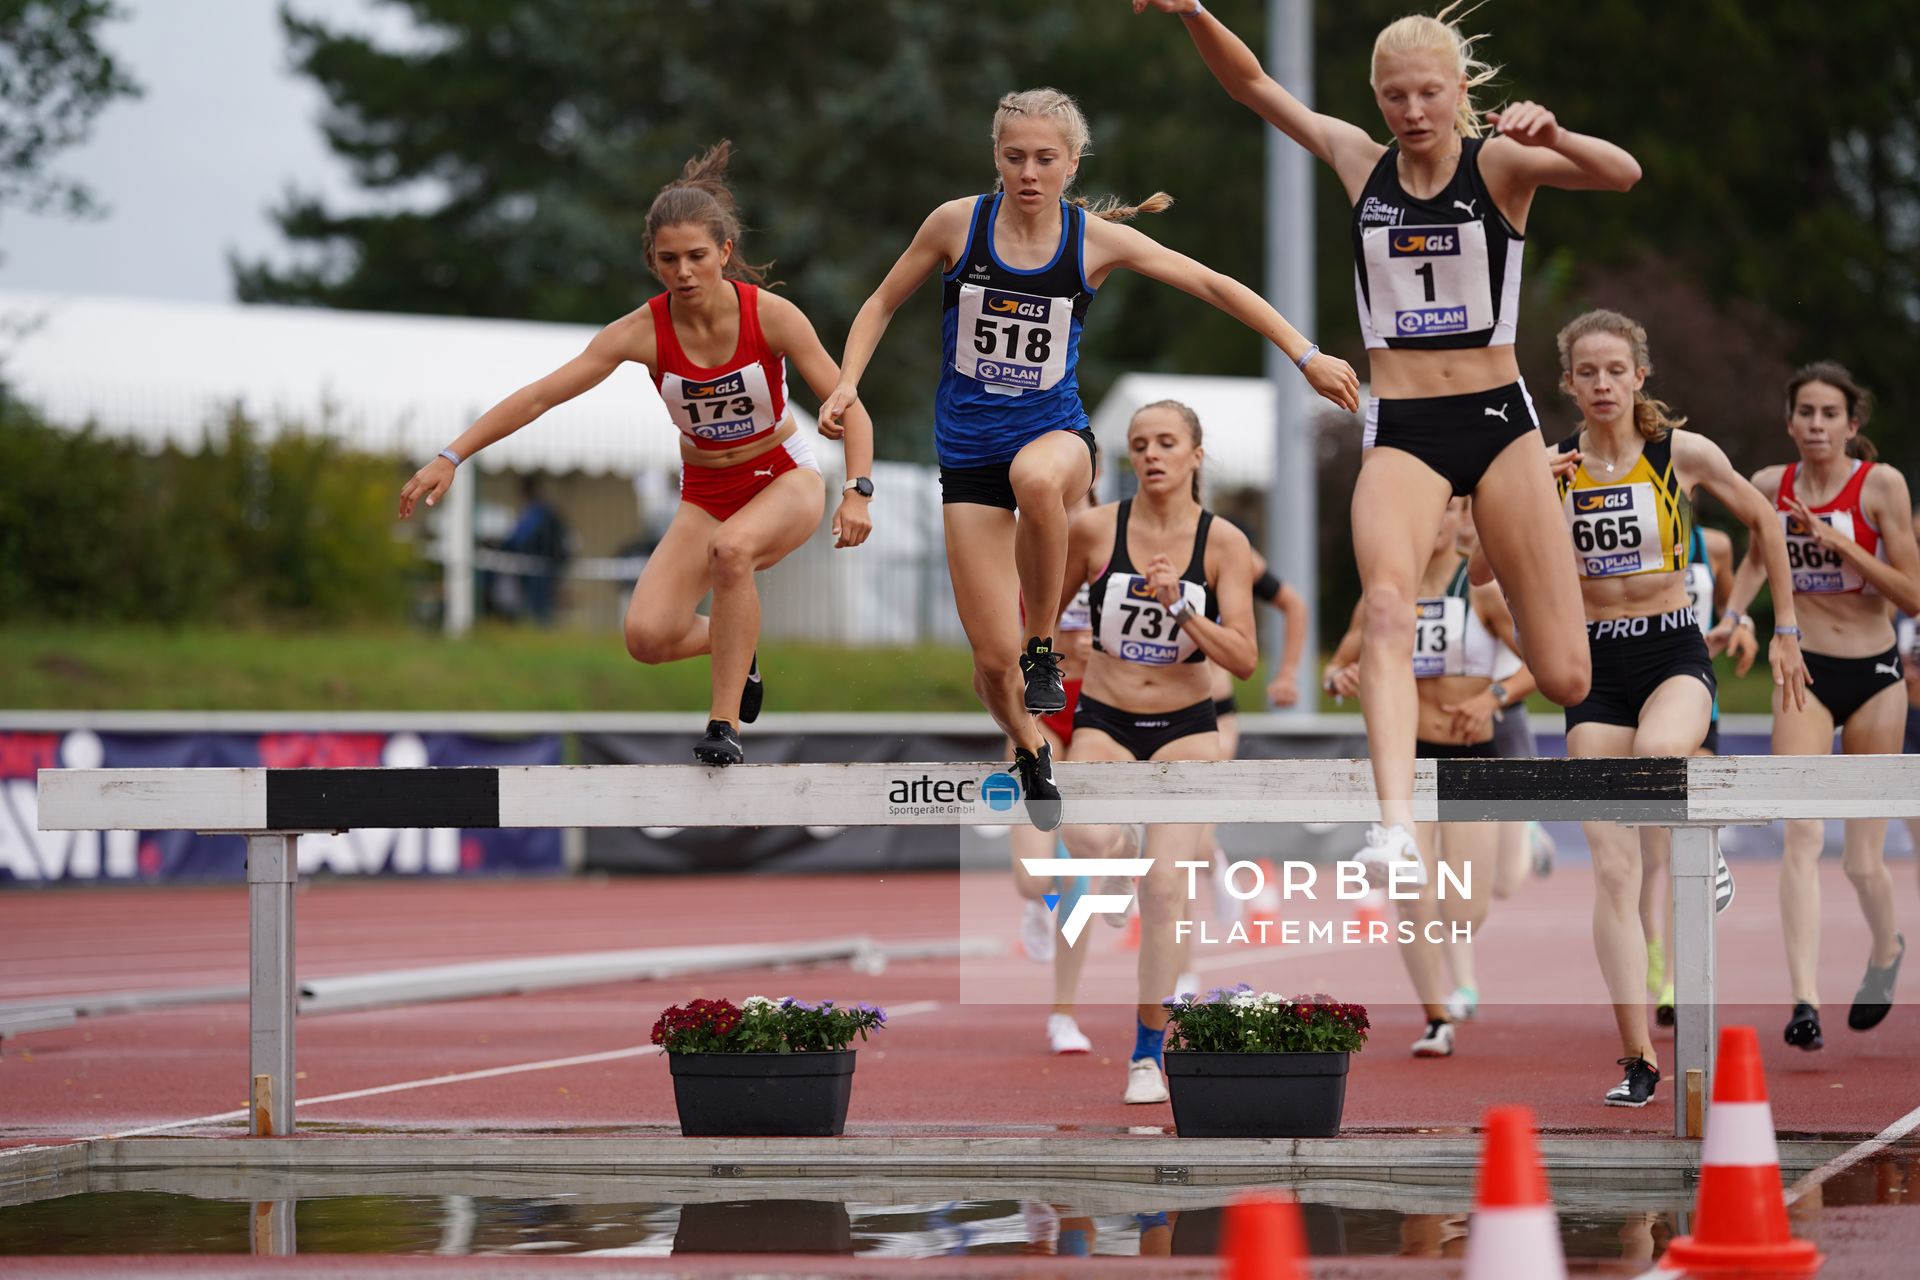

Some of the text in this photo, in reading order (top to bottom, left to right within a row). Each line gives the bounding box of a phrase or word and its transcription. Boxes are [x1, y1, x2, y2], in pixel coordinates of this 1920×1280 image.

[1425, 235, 1454, 252] GLS
[968, 273, 991, 281] erima
[1415, 262, 1436, 302] 1
[1017, 302, 1045, 318] GLS
[1424, 310, 1465, 326] PLAN
[974, 318, 1052, 363] 518
[1002, 366, 1039, 381] PLAN
[715, 379, 740, 394] GLS
[681, 396, 755, 424] 173
[716, 421, 752, 435] PLAN
[1604, 492, 1628, 509] GLS
[1572, 516, 1642, 553] 665
[1605, 554, 1639, 569] PLAN
[1595, 616, 1649, 640] PRO
[1144, 645, 1177, 658] PLAN
[889, 775, 975, 803] artec
[888, 805, 976, 817] Sportgeräte GmbH
